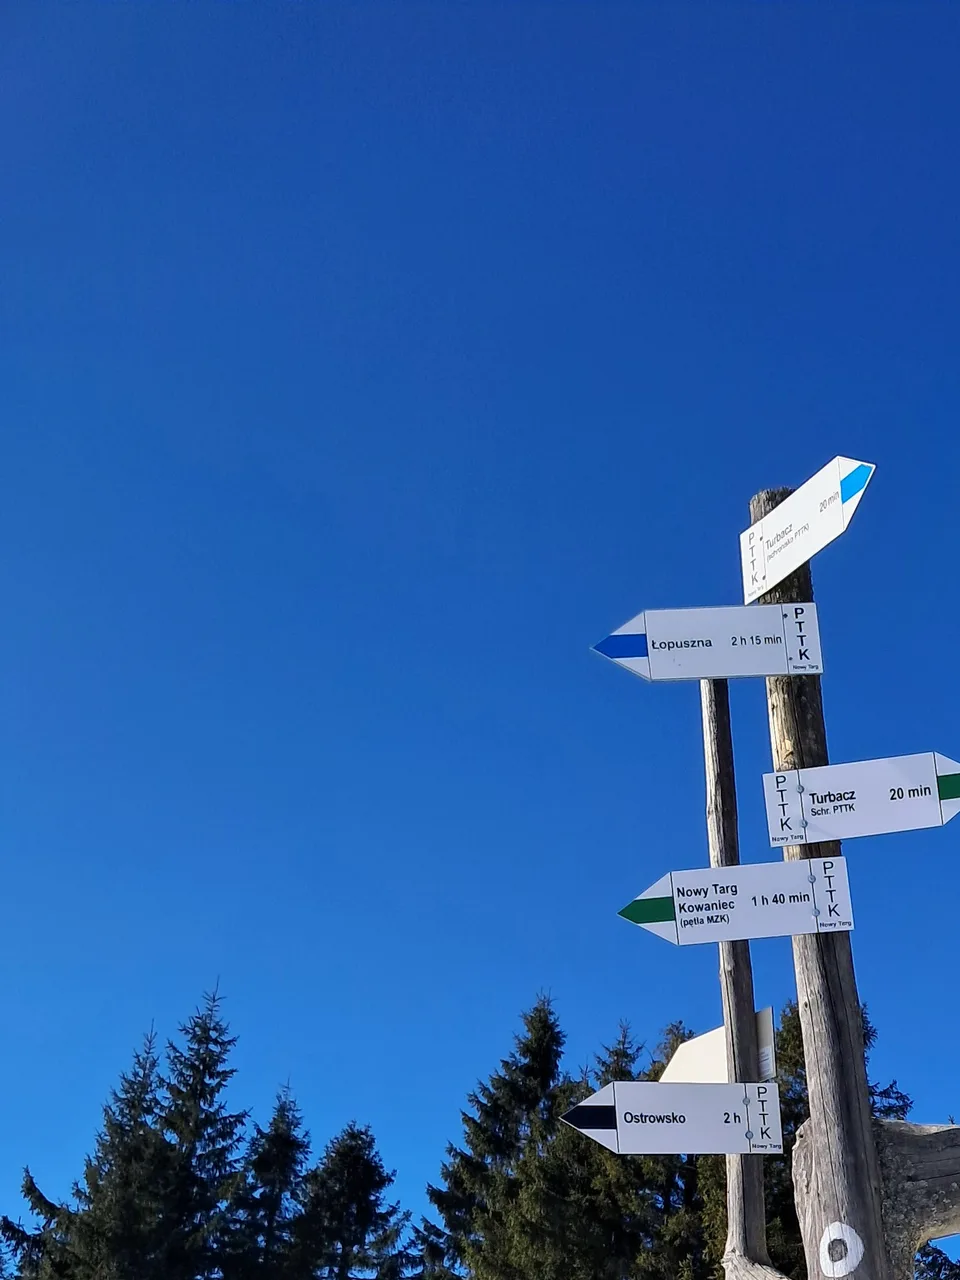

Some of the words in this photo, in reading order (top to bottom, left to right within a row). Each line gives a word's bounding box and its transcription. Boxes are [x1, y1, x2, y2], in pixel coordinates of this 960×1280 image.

[819, 499, 828, 513] 20
[828, 491, 840, 506] min
[765, 524, 793, 550] Turbacz
[748, 532, 759, 586] PTTK
[652, 638, 713, 652] Łopuszna
[731, 636, 738, 647] 2
[740, 636, 747, 645] h
[750, 635, 762, 645] 15
[764, 634, 783, 645] min
[794, 607, 811, 661] PTTK
[775, 775, 793, 832] PTTK
[809, 788, 857, 805] Turbacz
[889, 787, 904, 801] 20
[908, 784, 932, 799] min
[810, 807, 831, 817] Schr.
[833, 804, 856, 815] PTTK
[677, 885, 709, 899] Nowy
[712, 883, 738, 896] Targ
[751, 896, 757, 907] 1
[761, 895, 768, 906] h
[771, 894, 785, 905] 40
[789, 892, 811, 904] min
[822, 861, 841, 918] PTTK
[678, 900, 735, 914] Kowaniec
[707, 914, 730, 925] MZK)
[623, 1111, 687, 1124] Ostrowsko
[723, 1112, 731, 1124] 2
[733, 1111, 741, 1124] h
[757, 1086, 772, 1140] PTTK
